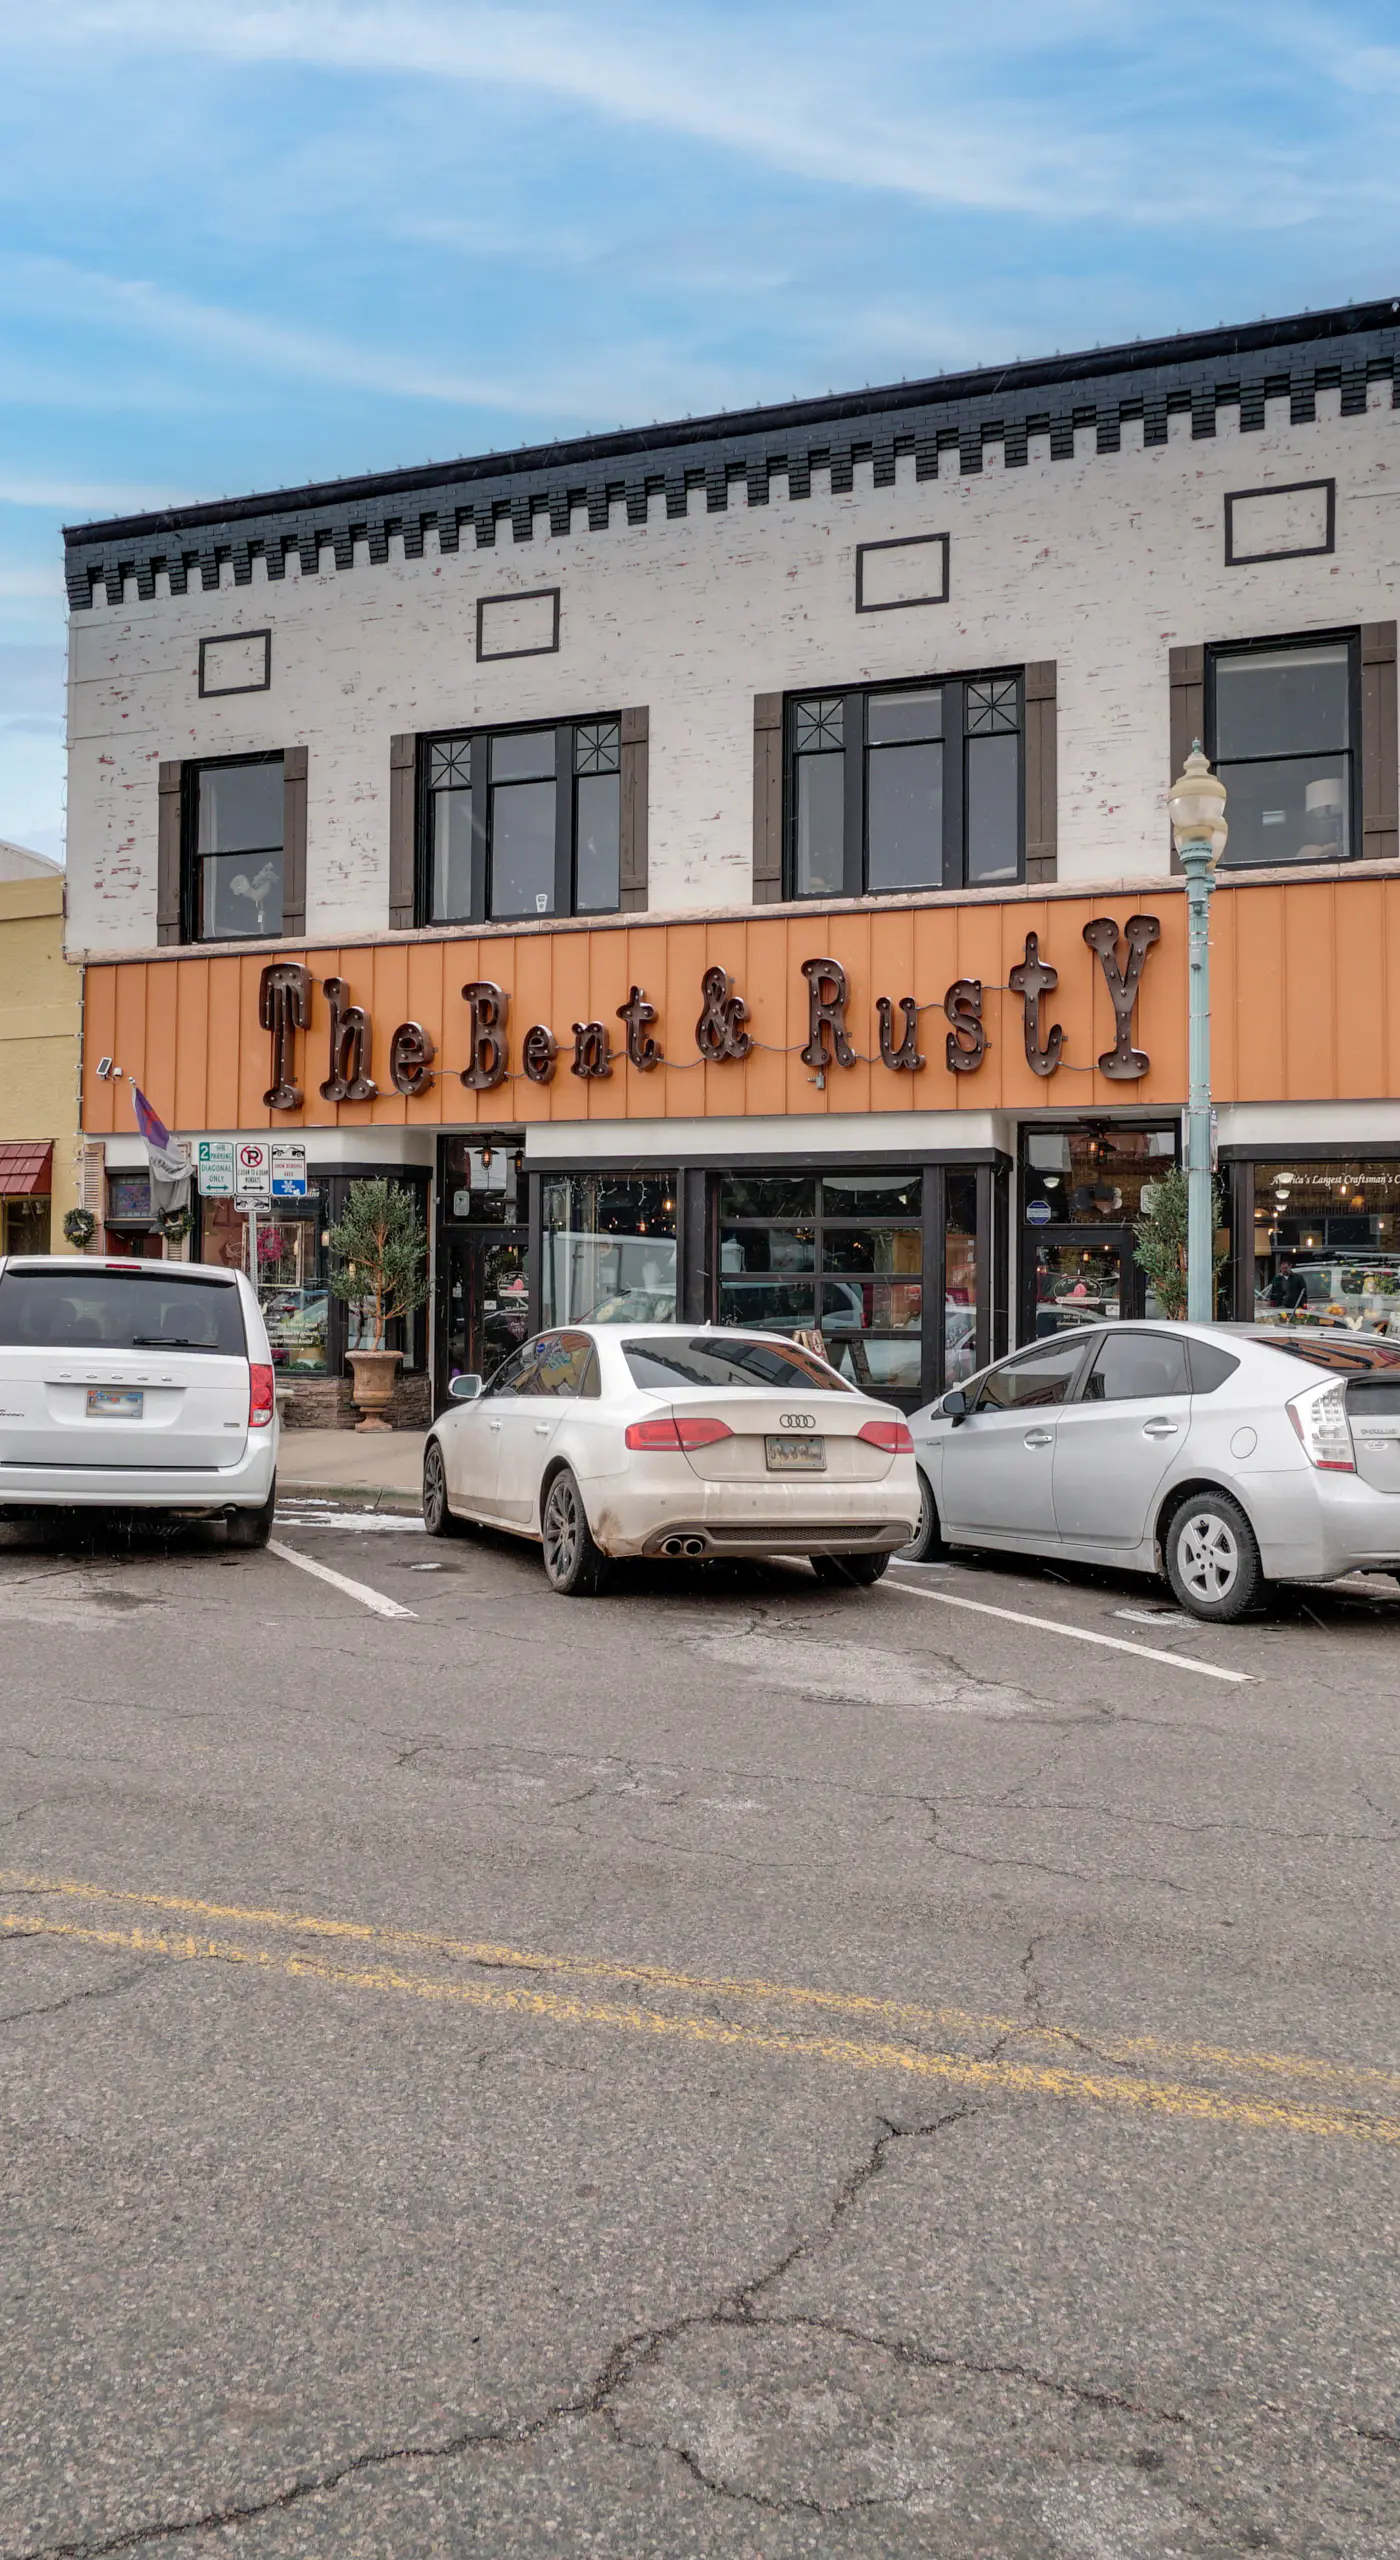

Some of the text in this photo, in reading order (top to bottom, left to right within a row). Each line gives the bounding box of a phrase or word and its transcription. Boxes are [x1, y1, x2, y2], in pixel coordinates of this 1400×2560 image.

[259, 962, 434, 1109] The
[460, 980, 661, 1090] Bent
[695, 965, 749, 1062] &
[200, 1145, 209, 1159] 2
[201, 1164, 232, 1172] DIAGONAL
[1270, 1175, 1310, 1186] Arica's
[1312, 1175, 1341, 1186] Largest
[1344, 1174, 1392, 1187] Craftsman's
